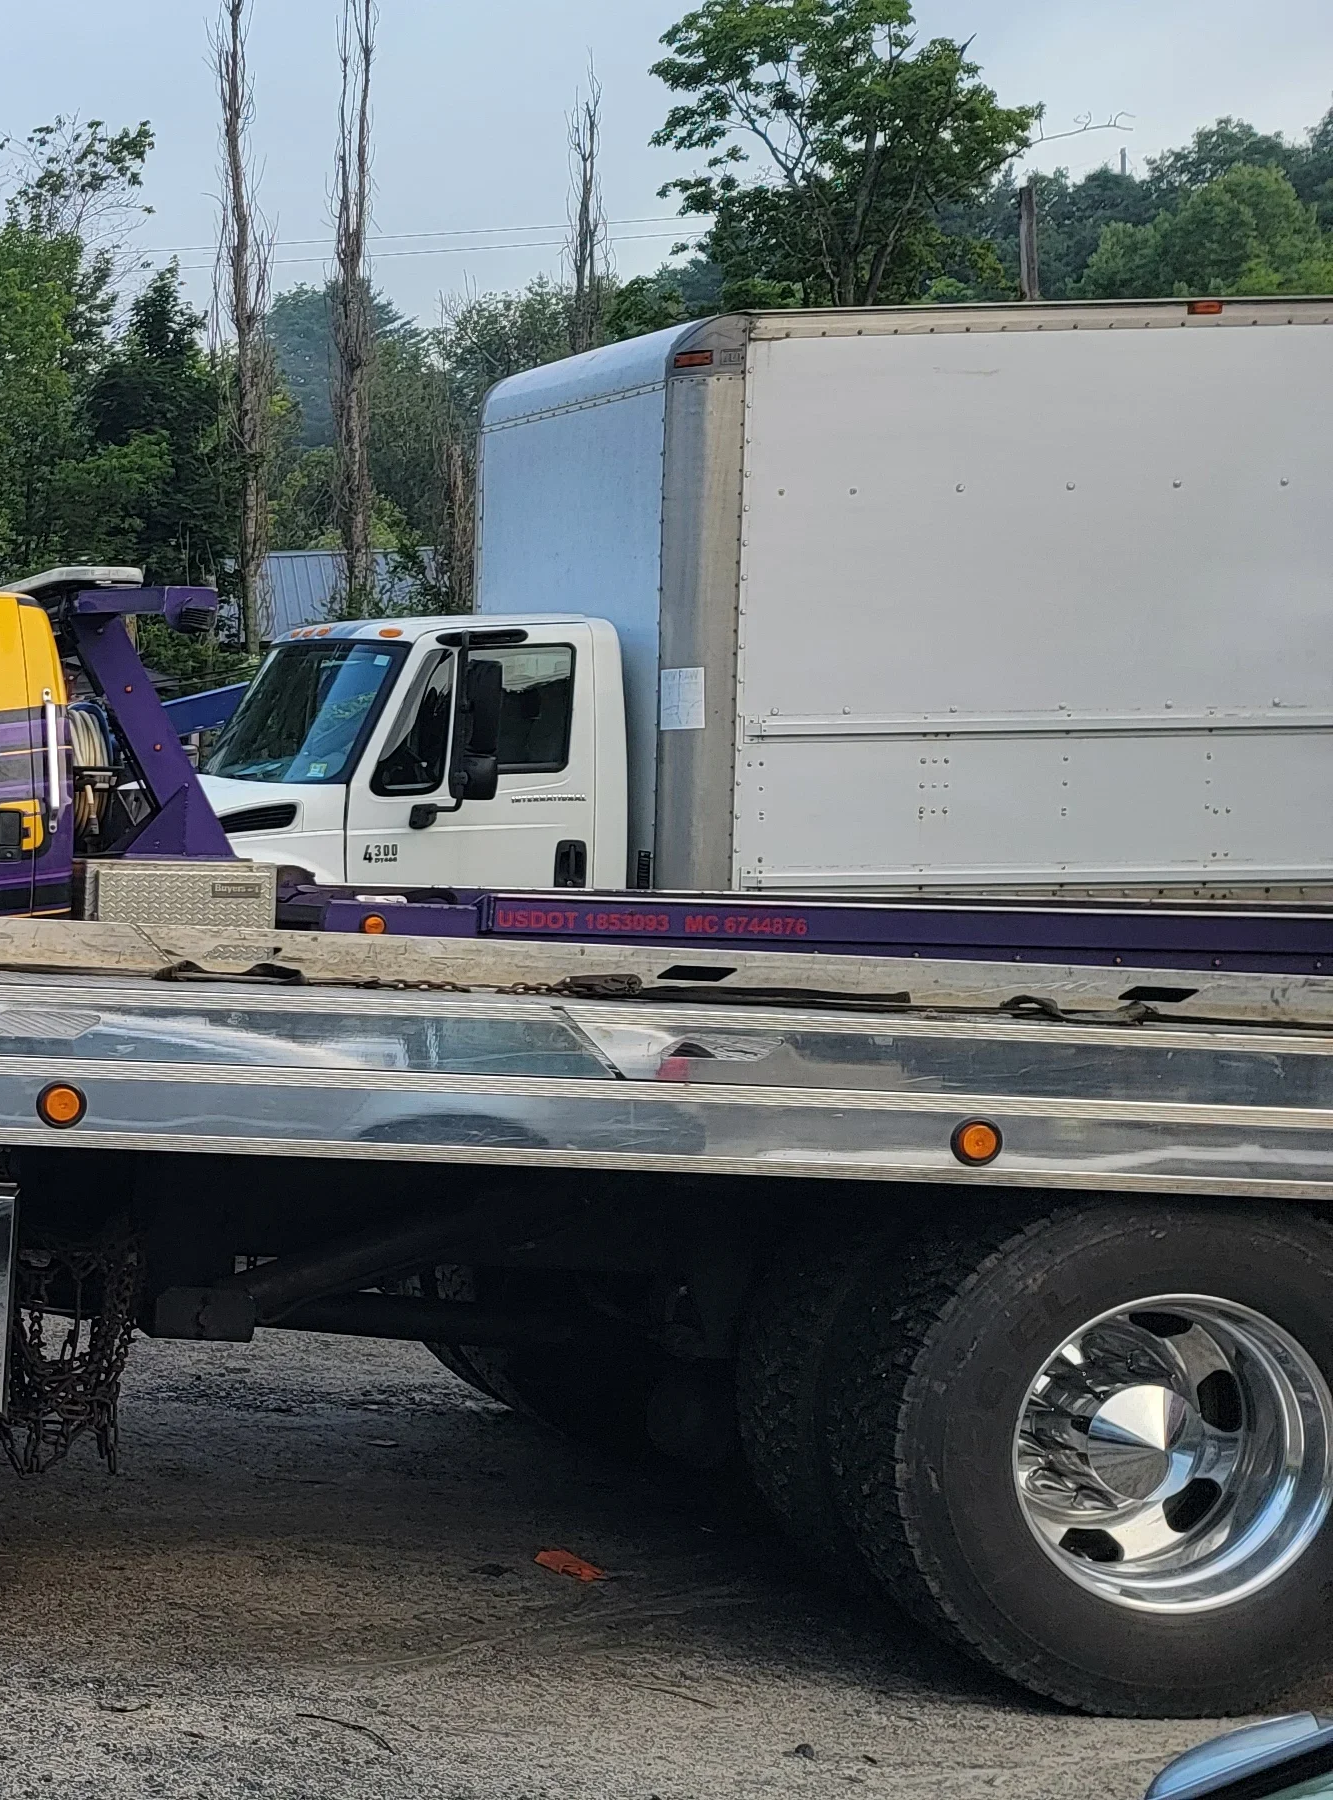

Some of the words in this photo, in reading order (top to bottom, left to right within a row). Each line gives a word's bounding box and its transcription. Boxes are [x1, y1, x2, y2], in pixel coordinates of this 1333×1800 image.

[362, 843, 398, 864] 4300
[497, 910, 579, 929] USDOT
[585, 912, 670, 932] 1853093
[684, 915, 719, 933] MC
[724, 916, 808, 935] 6744876
